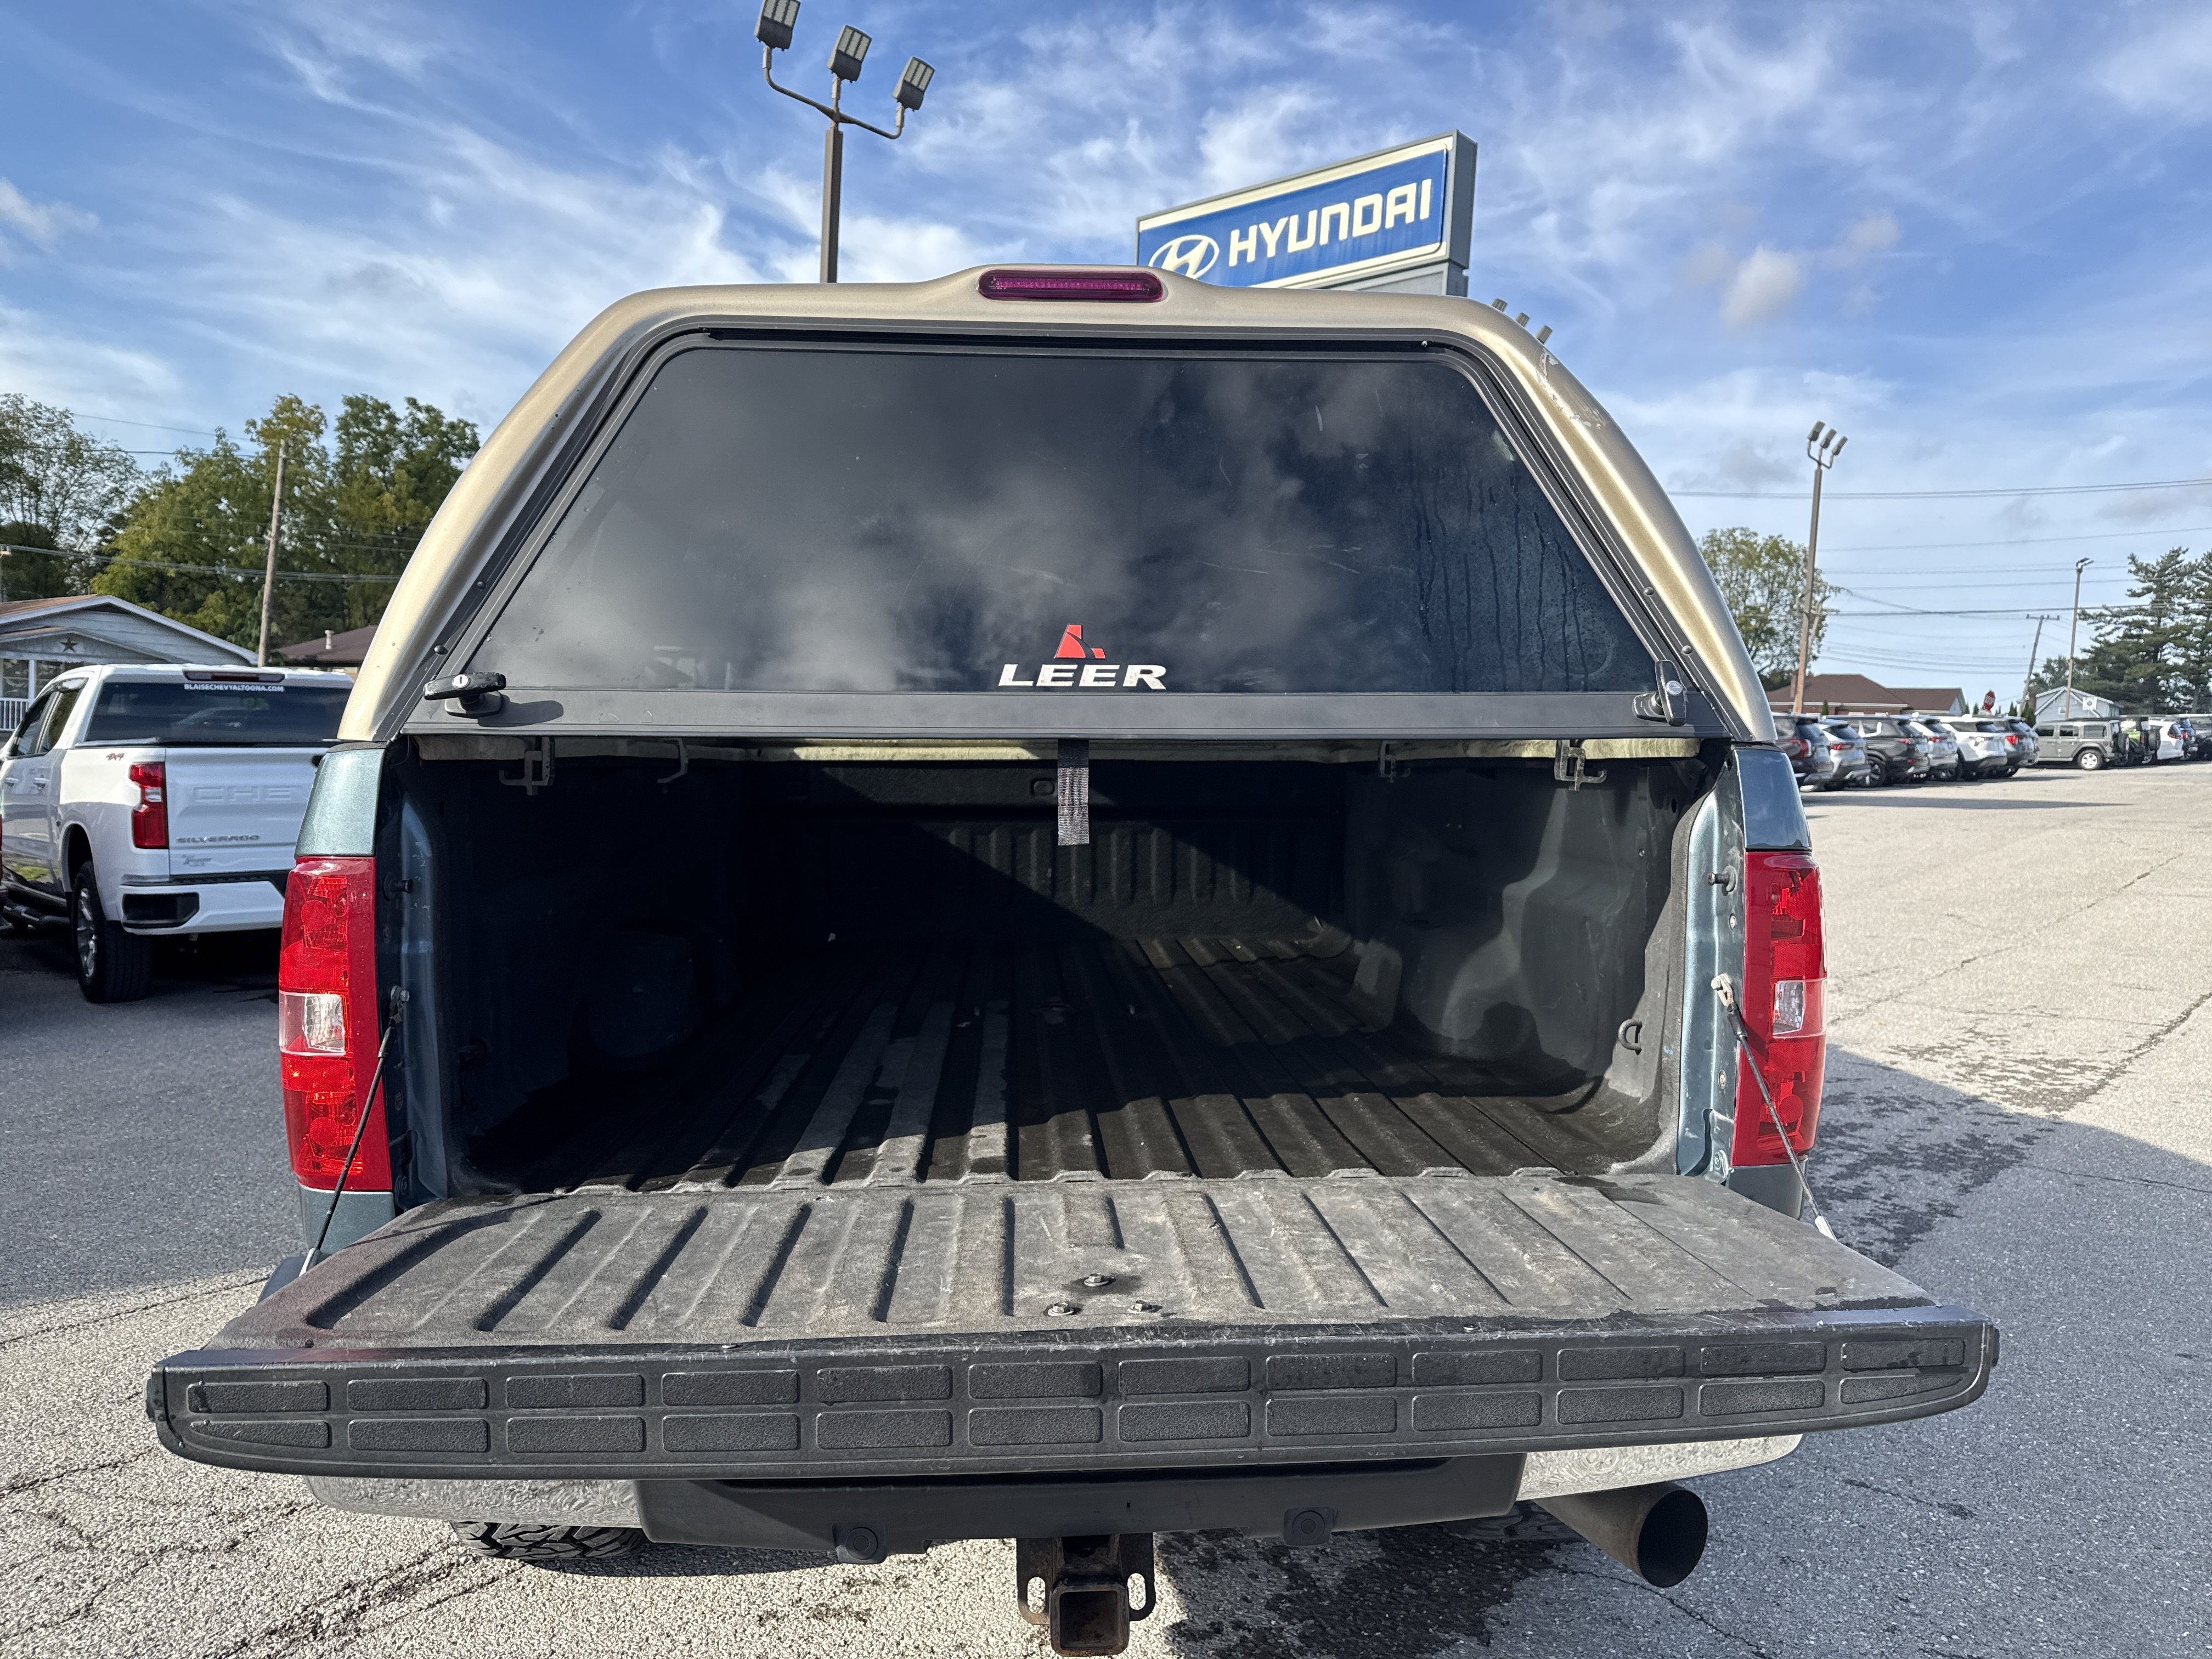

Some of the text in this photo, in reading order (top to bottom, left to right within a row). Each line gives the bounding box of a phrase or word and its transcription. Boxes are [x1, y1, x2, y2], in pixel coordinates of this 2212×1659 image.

[1228, 178, 1432, 267] HYUNDAI
[998, 663, 1167, 690] LEER
[184, 684, 284, 692] BLAISECHEVYALTOONA.COM
[176, 834, 259, 843] SILVERADO
